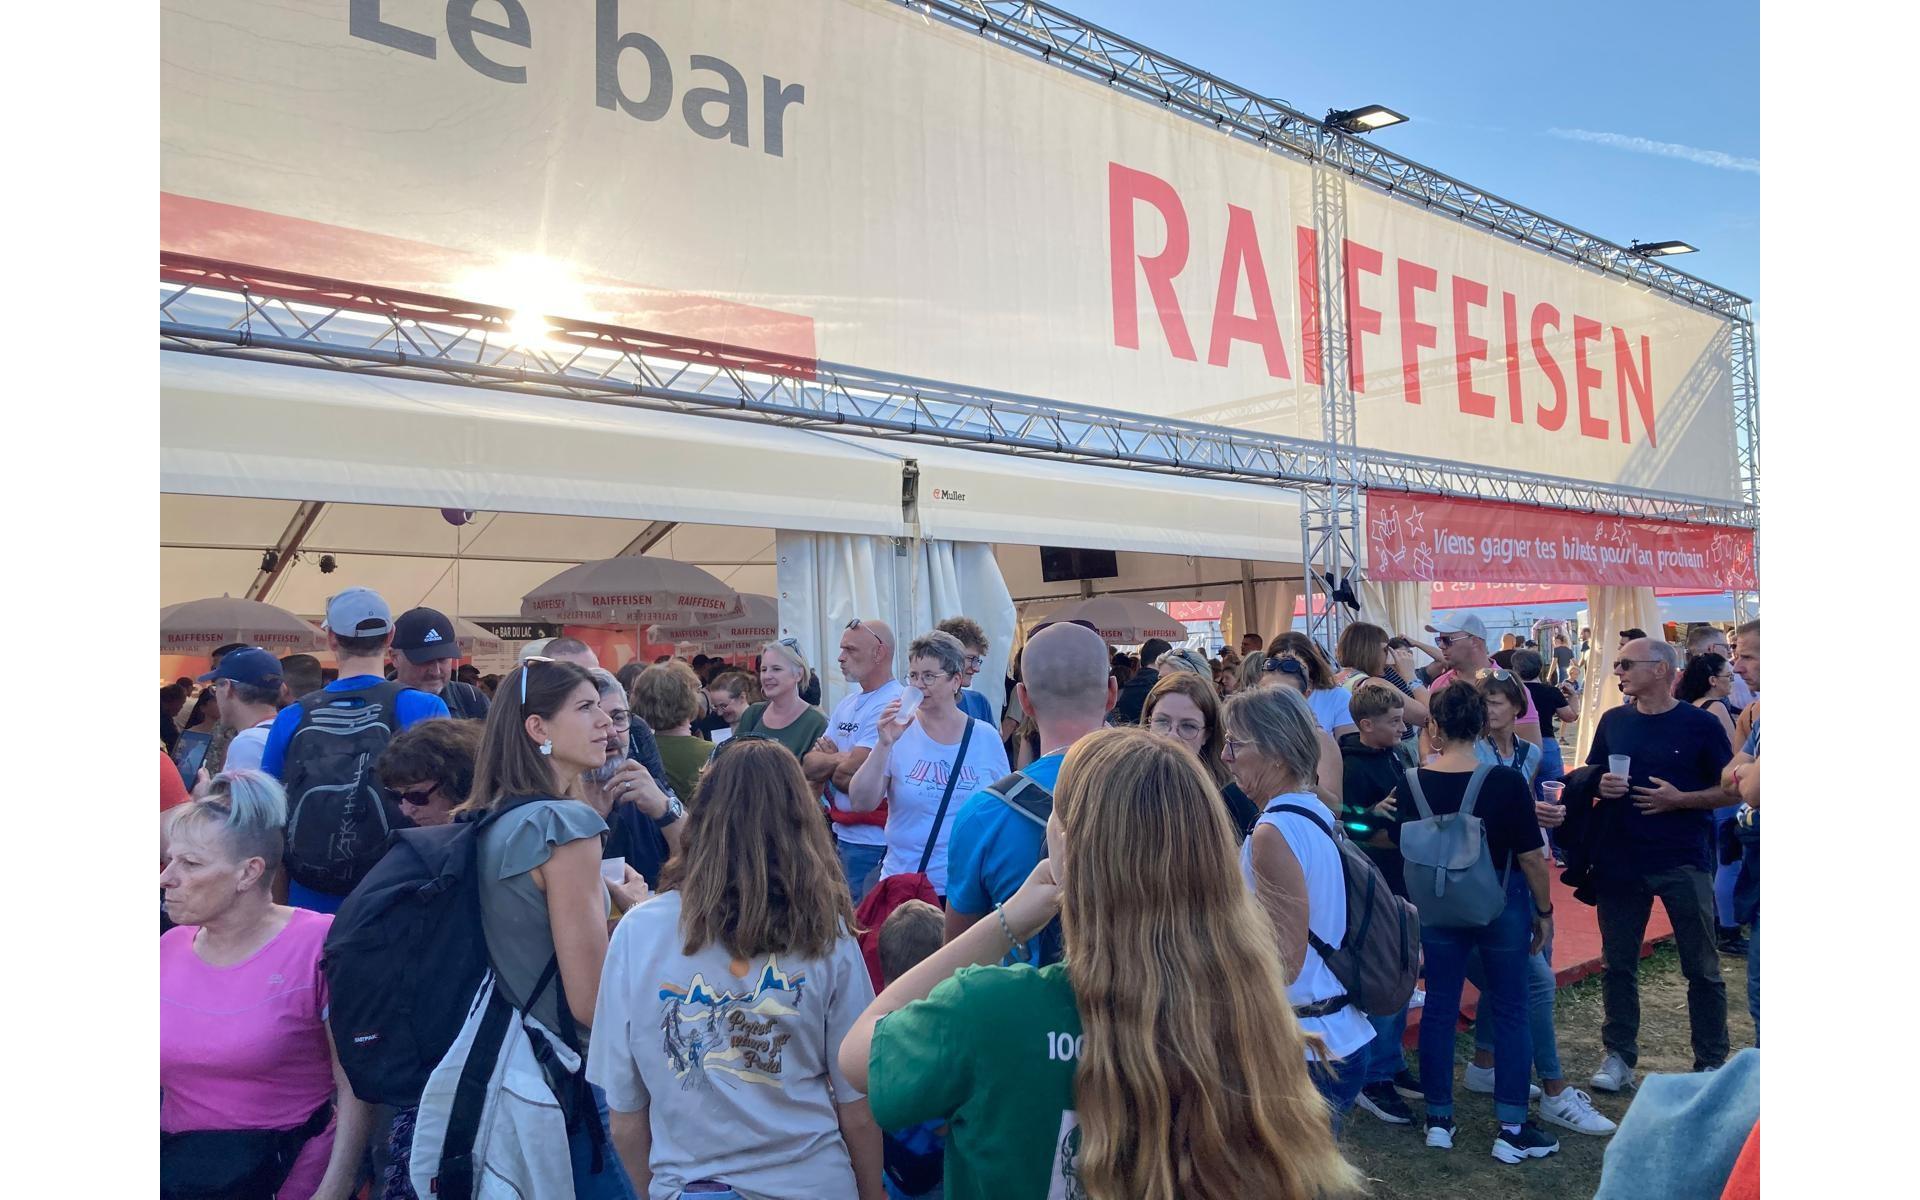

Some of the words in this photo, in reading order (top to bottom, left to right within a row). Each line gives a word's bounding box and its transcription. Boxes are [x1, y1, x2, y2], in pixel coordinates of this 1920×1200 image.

[596, 0, 805, 158] bar
[1108, 161, 1657, 449] RAIFFEISEN
[941, 489, 966, 501] Muller
[1433, 528, 1475, 556] Viens
[1480, 536, 1532, 564] gagner
[1534, 537, 1557, 560] tes
[1600, 544, 1632, 569] pour
[592, 595, 652, 605] RAIFFEISEN
[678, 595, 726, 610] RAIFFEISEN
[499, 626, 511, 637] BAR
[512, 626, 521, 637] DU
[522, 626, 532, 637] LAC
[730, 627, 776, 636] RAIFFEISEN
[1143, 629, 1176, 638] RAIFFEISEN
[168, 633, 224, 643] RAIFFEISEN
[253, 633, 301, 643] RAIFFEISEN
